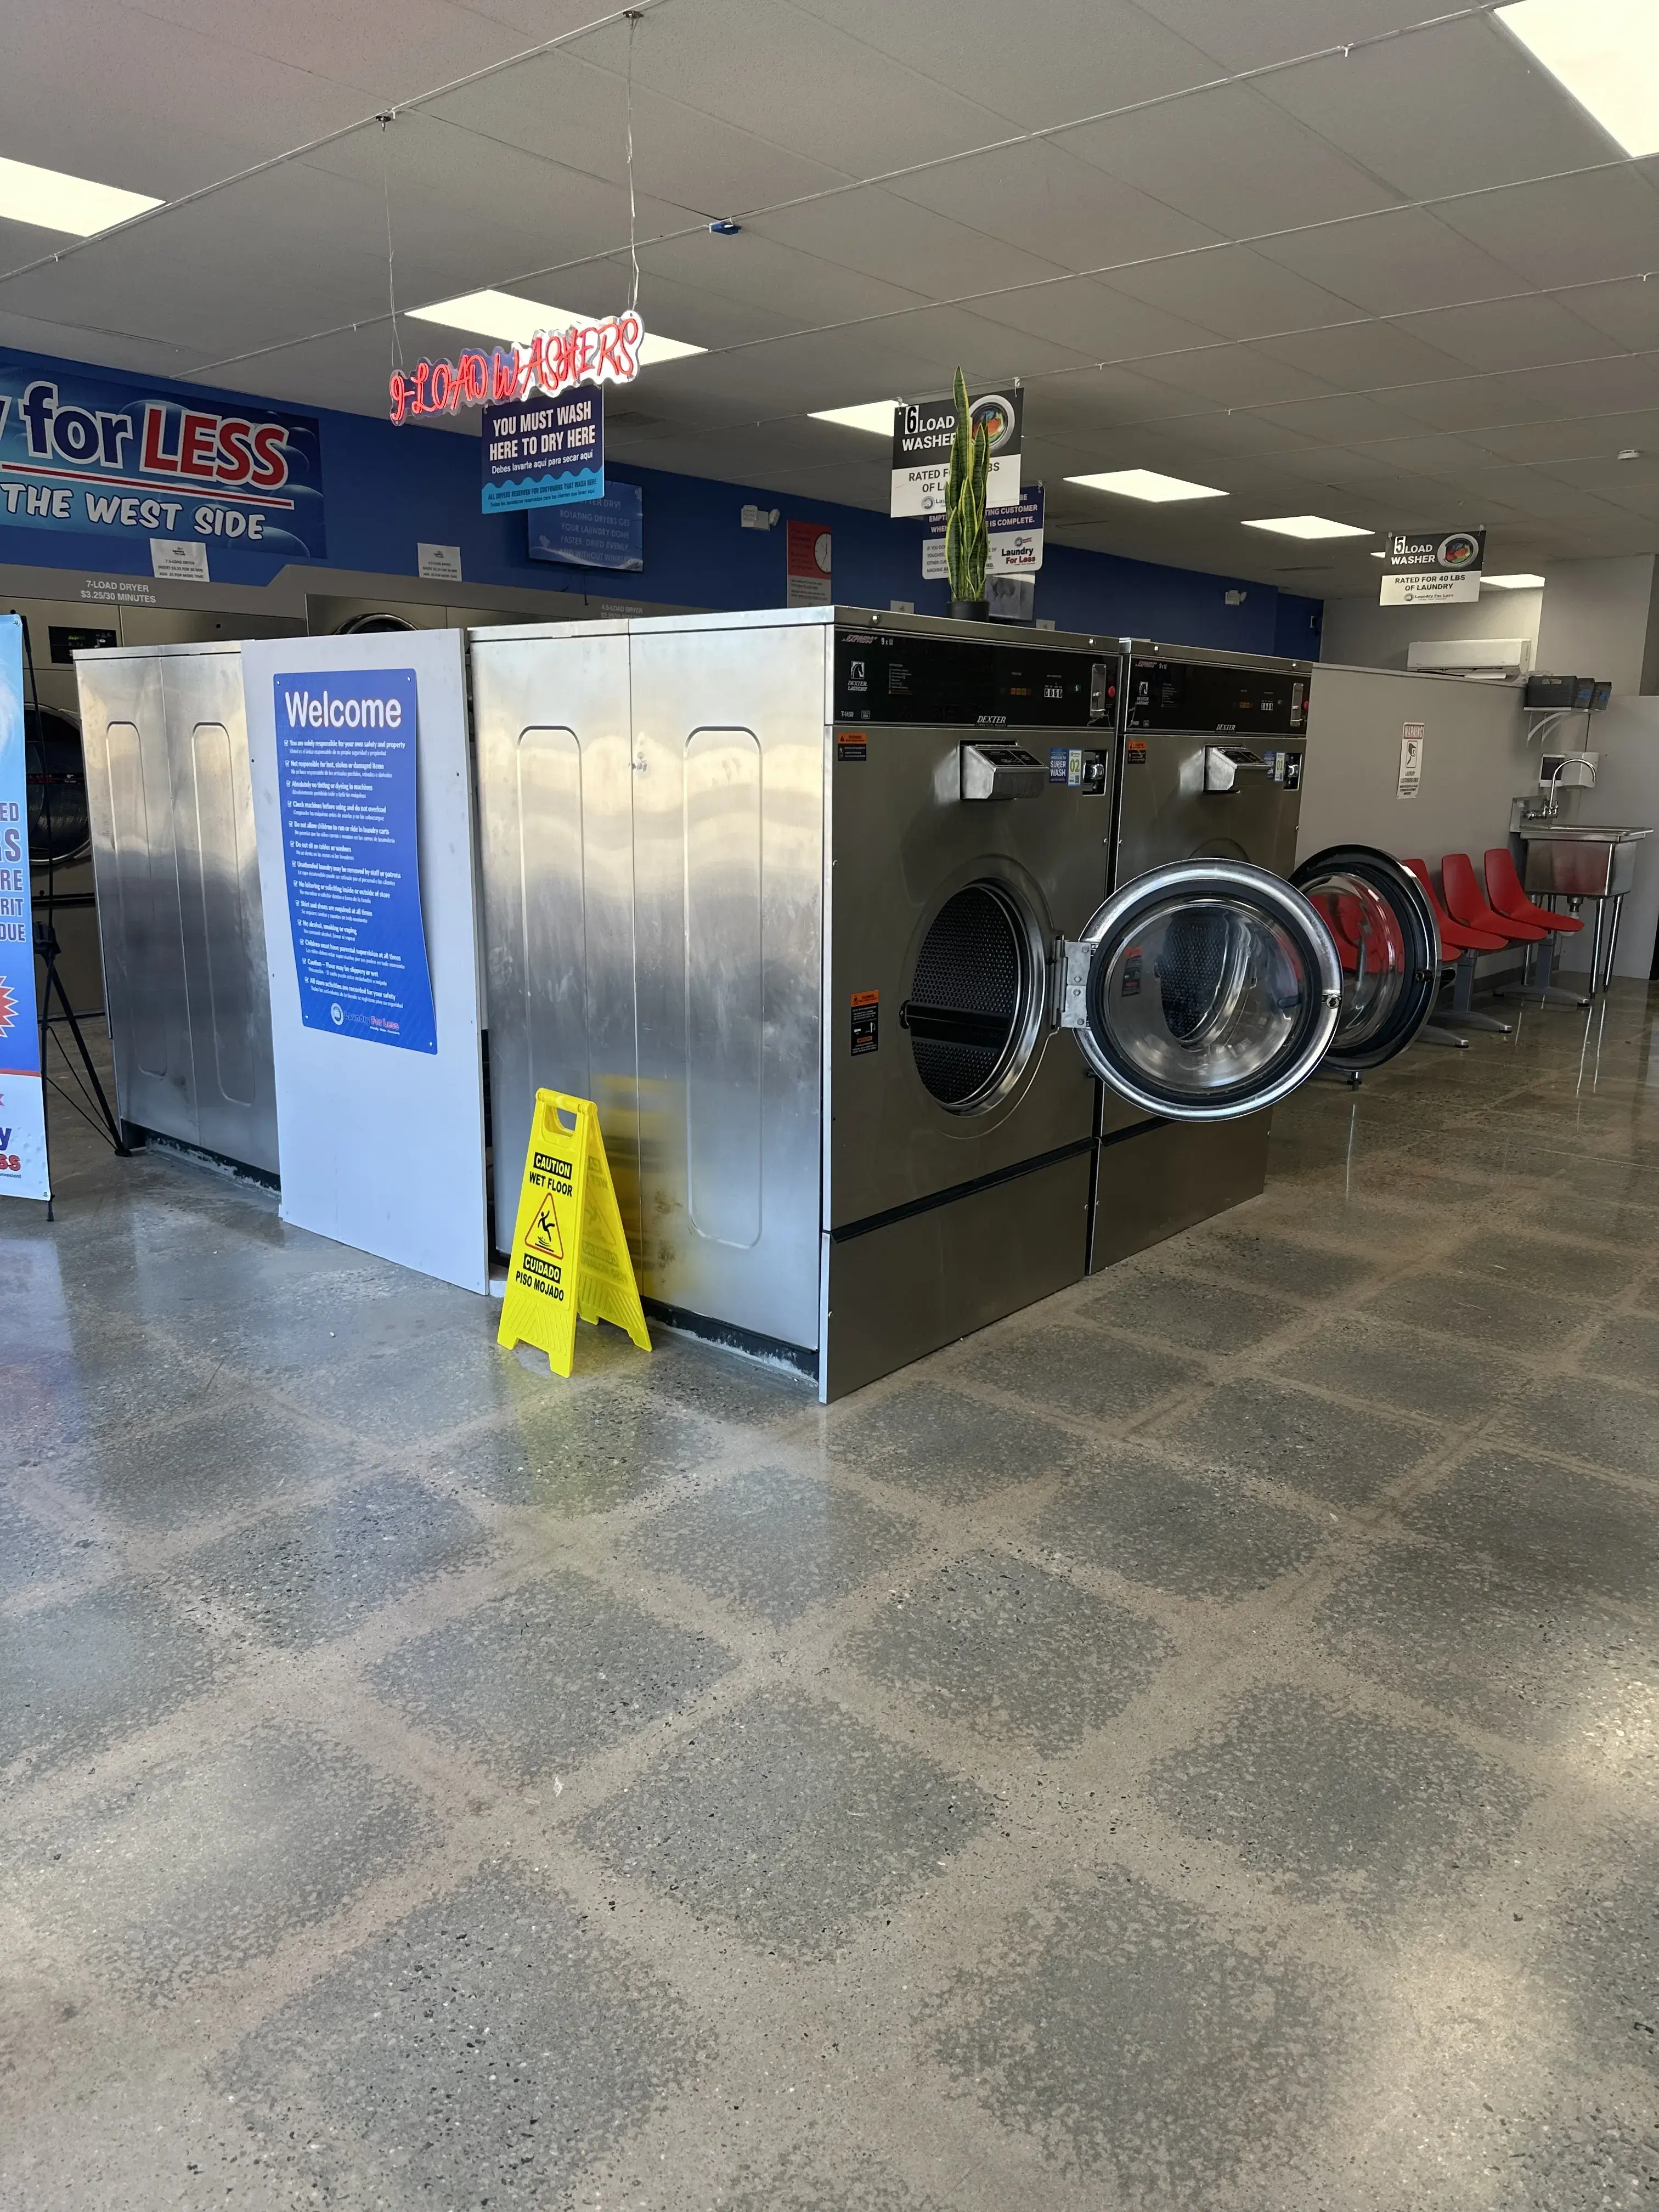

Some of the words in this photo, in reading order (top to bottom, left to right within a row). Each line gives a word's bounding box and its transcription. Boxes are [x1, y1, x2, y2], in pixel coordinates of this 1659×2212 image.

[493, 318, 638, 399] WASHERS
[493, 417, 516, 438] YOU
[520, 409, 553, 433] MUST
[557, 400, 591, 426] WASH
[907, 407, 917, 433] 6
[919, 416, 955, 432] LOAD
[20, 382, 132, 469] for
[140, 404, 290, 490] LESS
[489, 439, 518, 461] HERE
[522, 438, 537, 455] TO
[540, 431, 564, 454] DRY
[567, 425, 595, 449] HERE
[492, 465, 511, 475] Debes
[512, 461, 532, 472] lavarte
[534, 458, 546, 471] aquí
[548, 458, 561, 469] para
[562, 454, 578, 465] secar
[580, 448, 593, 462] aquí
[909, 470, 940, 482] RATED
[496, 492, 511, 500] DRYERS
[511, 489, 531, 498] RESERVED
[540, 484, 563, 494] CUSTOMERS
[564, 482, 574, 490] THAT
[587, 478, 597, 486] HERE
[922, 483, 935, 493] OF
[1, 483, 73, 518] THE
[86, 493, 182, 531] WEST
[194, 505, 266, 539] SIDE
[604, 499, 620, 509] DRY!
[1001, 504, 1037, 515] CUSTOMER
[560, 510, 592, 521] ROTATING
[594, 515, 617, 525] DRYERS
[619, 518, 630, 527] GET
[997, 516, 1035, 526] COMPLETE.
[561, 522, 579, 532] YOUR
[581, 525, 610, 535] LAUNDRY
[611, 530, 629, 539] DONE
[586, 539, 604, 548] DRIED
[1001, 547, 1034, 557] Laundry
[1396, 536, 1404, 554] 5
[1405, 544, 1433, 554] LOAD
[576, 550, 603, 560] WITHOUT
[1391, 555, 1435, 565] WASHER
[86, 580, 117, 591] 7-LOAD
[120, 582, 149, 593] DRYER
[1395, 576, 1420, 584] RATED
[81, 590, 115, 601] $3.25/30
[117, 592, 156, 604] MINUTES
[881, 637, 885, 645] 9
[285, 690, 402, 727] Welcome
[304, 740, 314, 748] solely
[315, 740, 337, 748] responsible
[353, 761, 371, 770] damaged
[1050, 769, 1066, 777] WASH
[1070, 759, 1080, 773] 02
[0, 803, 19, 822] ED
[0, 869, 22, 891] RE
[0, 898, 24, 916] RIT
[344, 1010, 370, 1025] Laundry
[370, 1015, 382, 1027] For
[382, 1018, 399, 1030] Less
[535, 1155, 571, 1177] CAUTION
[529, 1171, 544, 1187] WET
[548, 1178, 573, 1198] FLOOR
[525, 1256, 560, 1281] CUIDADO
[516, 1271, 532, 1288] PISO
[534, 1278, 565, 1302] MOJADO
